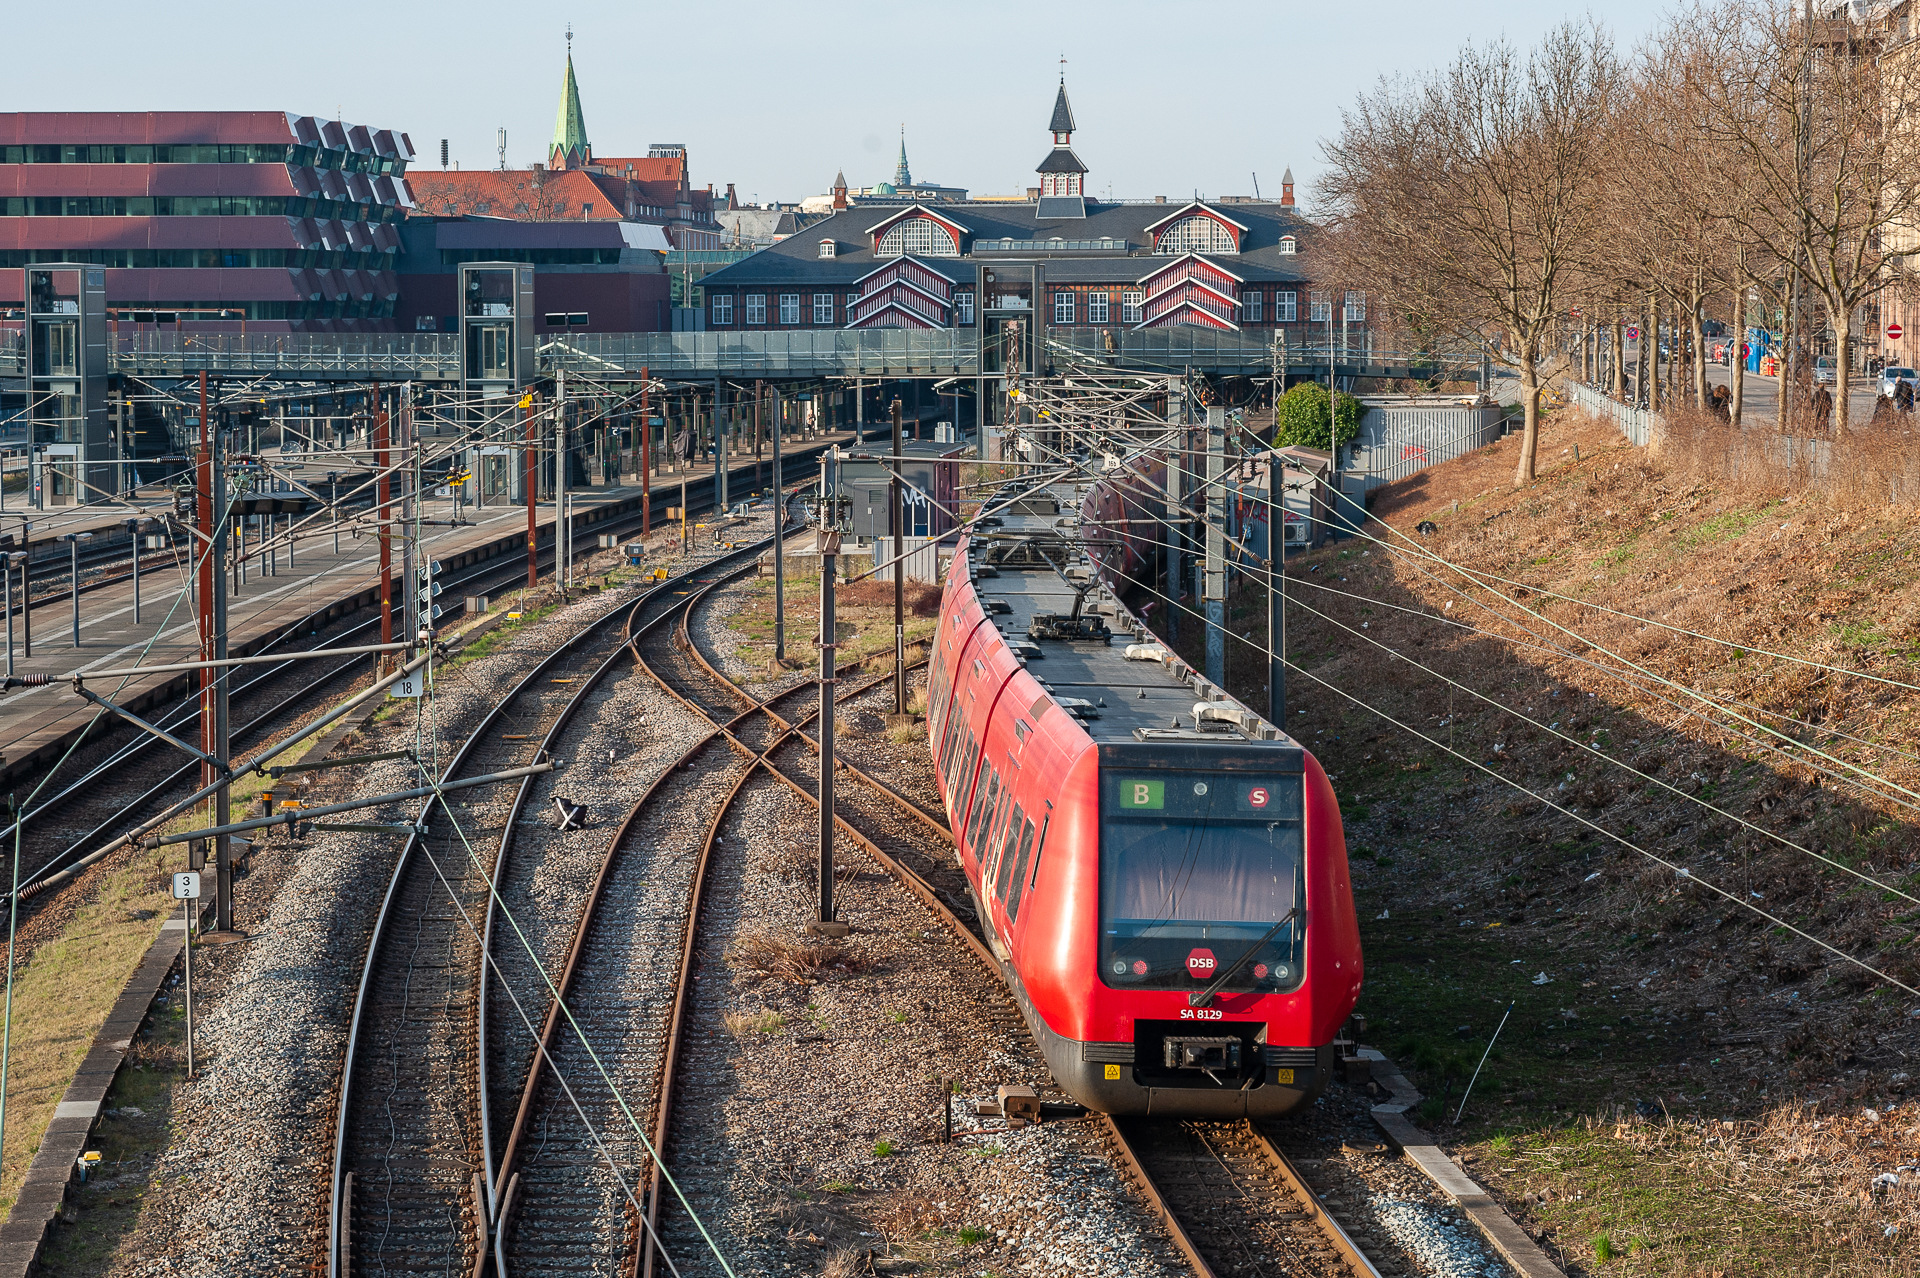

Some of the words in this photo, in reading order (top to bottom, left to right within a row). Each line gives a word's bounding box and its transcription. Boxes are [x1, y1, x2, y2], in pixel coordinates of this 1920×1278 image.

[402, 681, 413, 695] 18
[1134, 784, 1149, 804] B
[1252, 790, 1265, 804] S
[182, 876, 190, 886] 3
[183, 889, 190, 897] 2
[1189, 957, 1214, 968] DSB
[1180, 1009, 1195, 1019] SA
[1196, 1009, 1223, 1020] 8129
